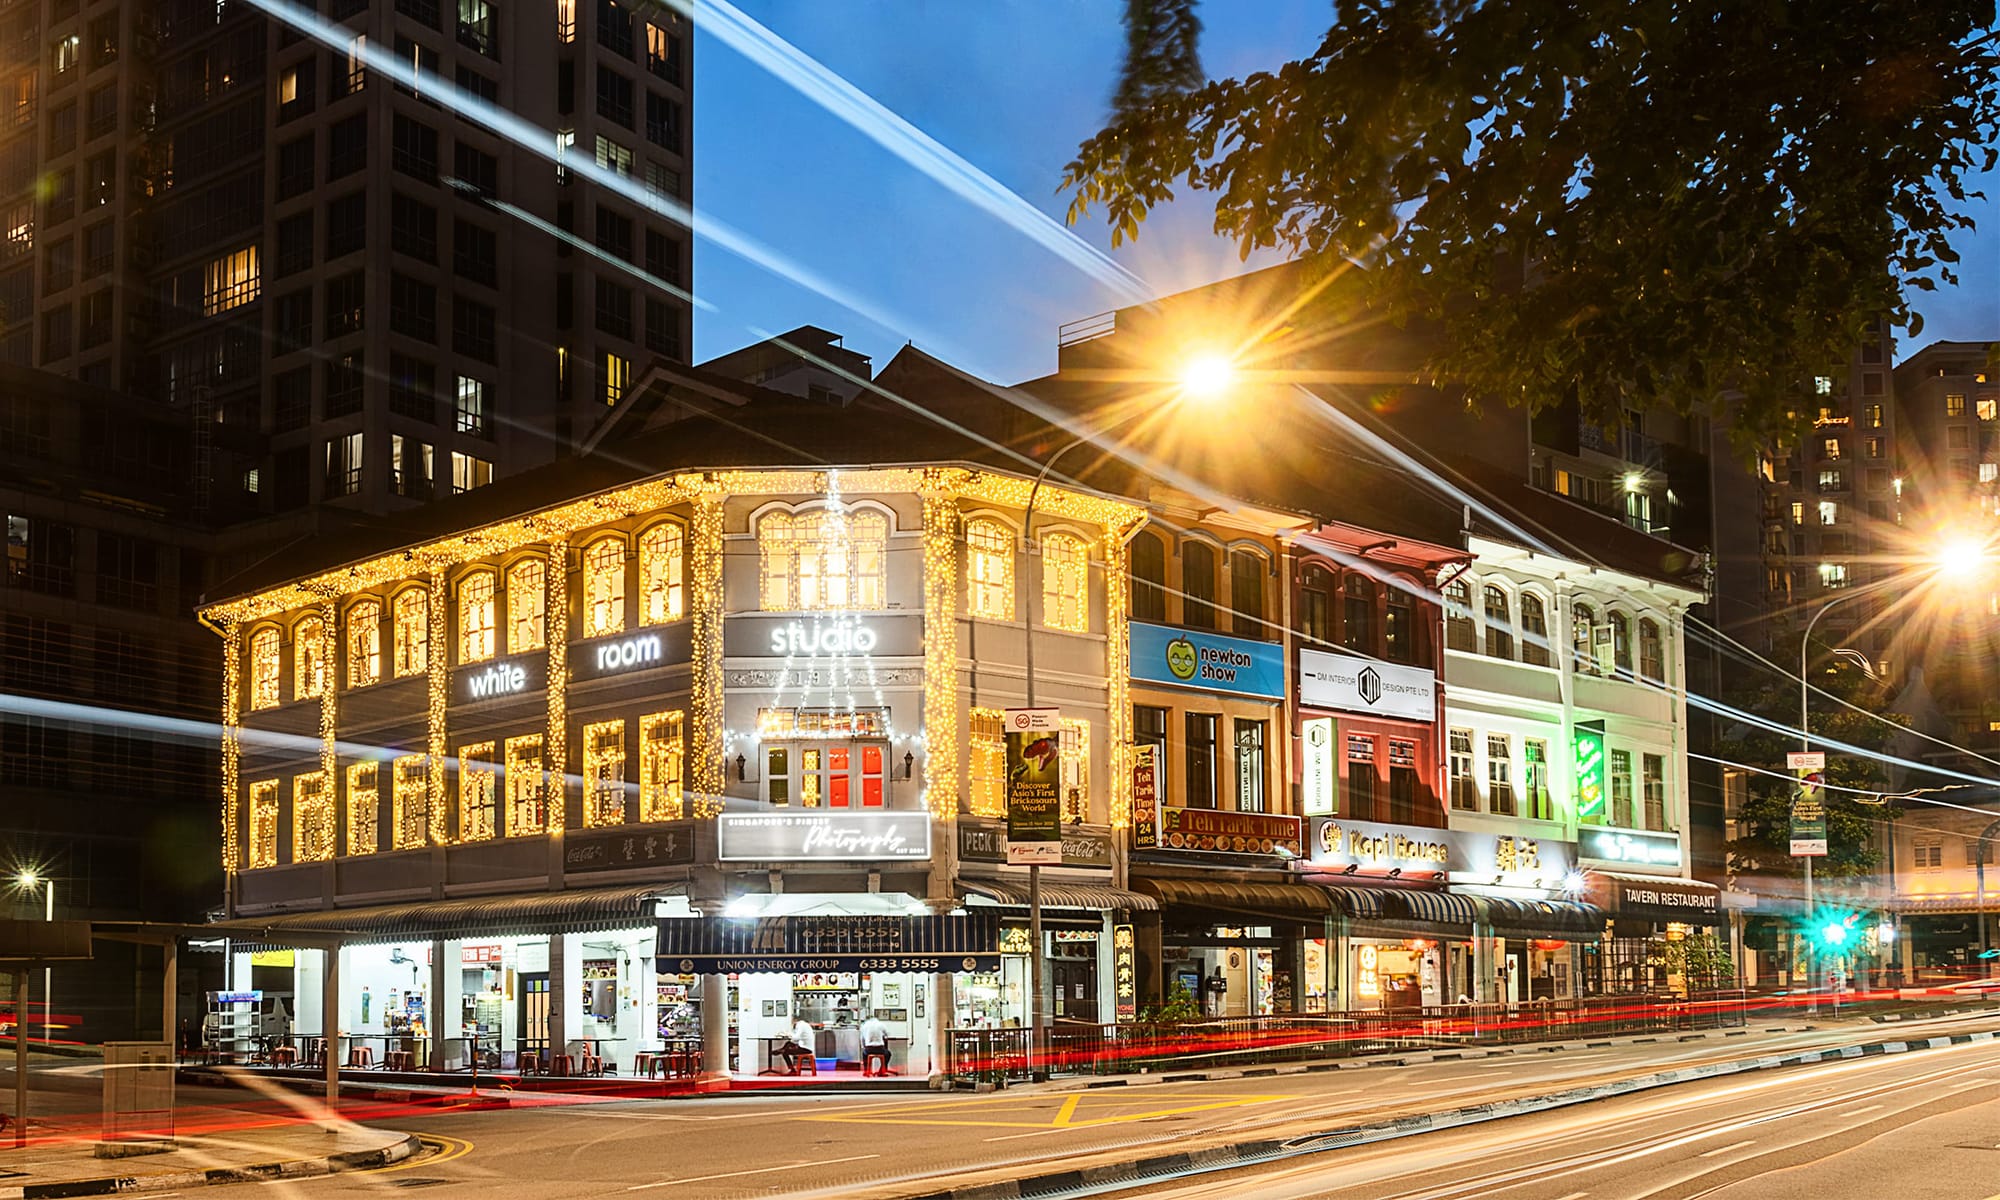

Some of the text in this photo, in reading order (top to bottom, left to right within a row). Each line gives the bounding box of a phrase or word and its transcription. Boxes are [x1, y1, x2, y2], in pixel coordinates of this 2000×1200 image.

[771, 621, 876, 652] studio
[598, 636, 660, 669] room
[1201, 648, 1251, 667] newton
[1201, 662, 1236, 682] show
[469, 665, 525, 697] white
[1329, 674, 1356, 686] INTERIOR
[1382, 682, 1430, 697] DESIGN PTE LTD
[1137, 772, 1152, 783] Teh
[1016, 782, 1050, 790] Discover
[1135, 785, 1153, 796] Tarik
[1012, 789, 1055, 797] Asia's First
[1022, 804, 1046, 812] World
[1136, 799, 1153, 810] Time
[1139, 823, 1151, 834] 24
[1186, 811, 1295, 837] Teh Tarik Time
[803, 825, 906, 853] Photography
[966, 832, 992, 852] PECK
[995, 834, 1008, 853] HO
[1137, 835, 1155, 845] HRS
[1349, 829, 1389, 862] Kopi
[1392, 834, 1449, 864] House
[1625, 888, 1716, 908] TAVERN RESTAURANT
[802, 927, 900, 938] 6333 5555
[717, 959, 840, 969] UNION ENERGY GROUP
[859, 959, 939, 969] 6333 5555
